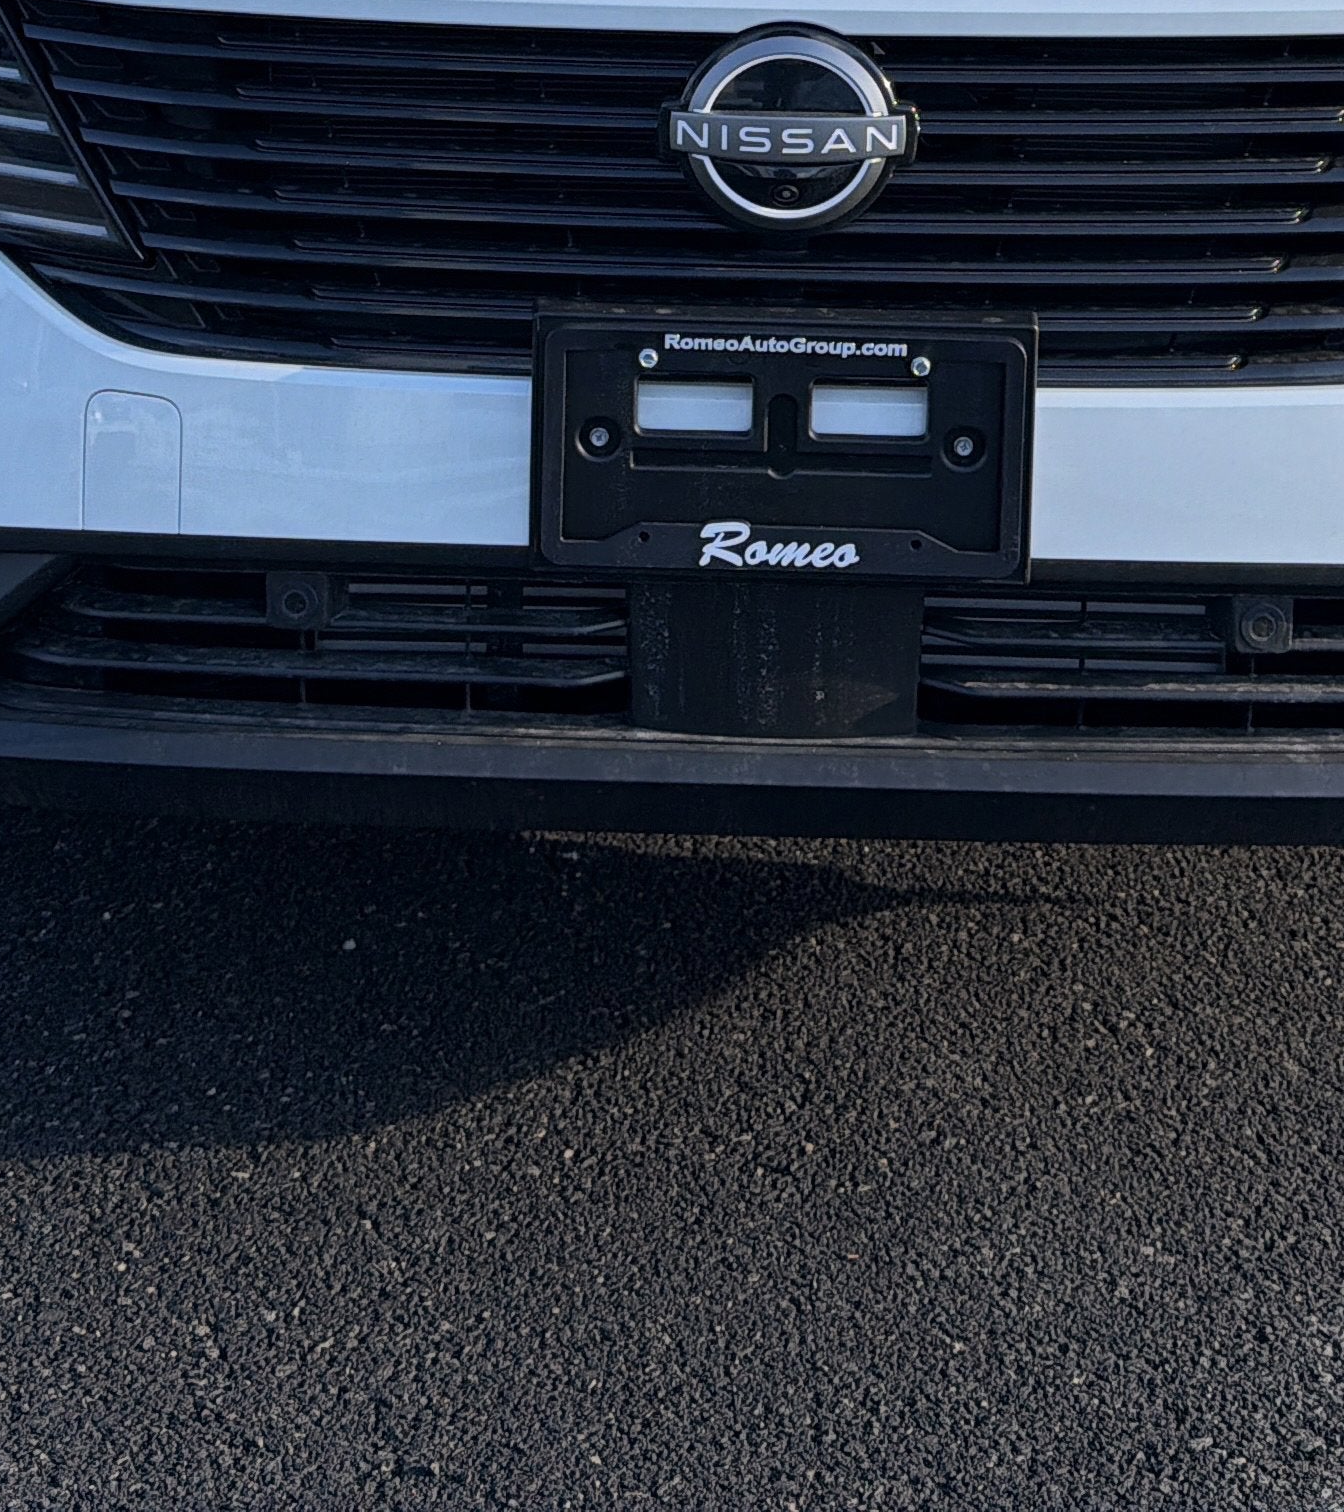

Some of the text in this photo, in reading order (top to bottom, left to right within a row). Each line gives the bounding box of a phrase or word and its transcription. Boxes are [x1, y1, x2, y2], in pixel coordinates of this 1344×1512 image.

[676, 119, 898, 155] NISSAN
[663, 333, 908, 359] RomeoAutoGroup.com
[698, 521, 860, 569] Romeo
